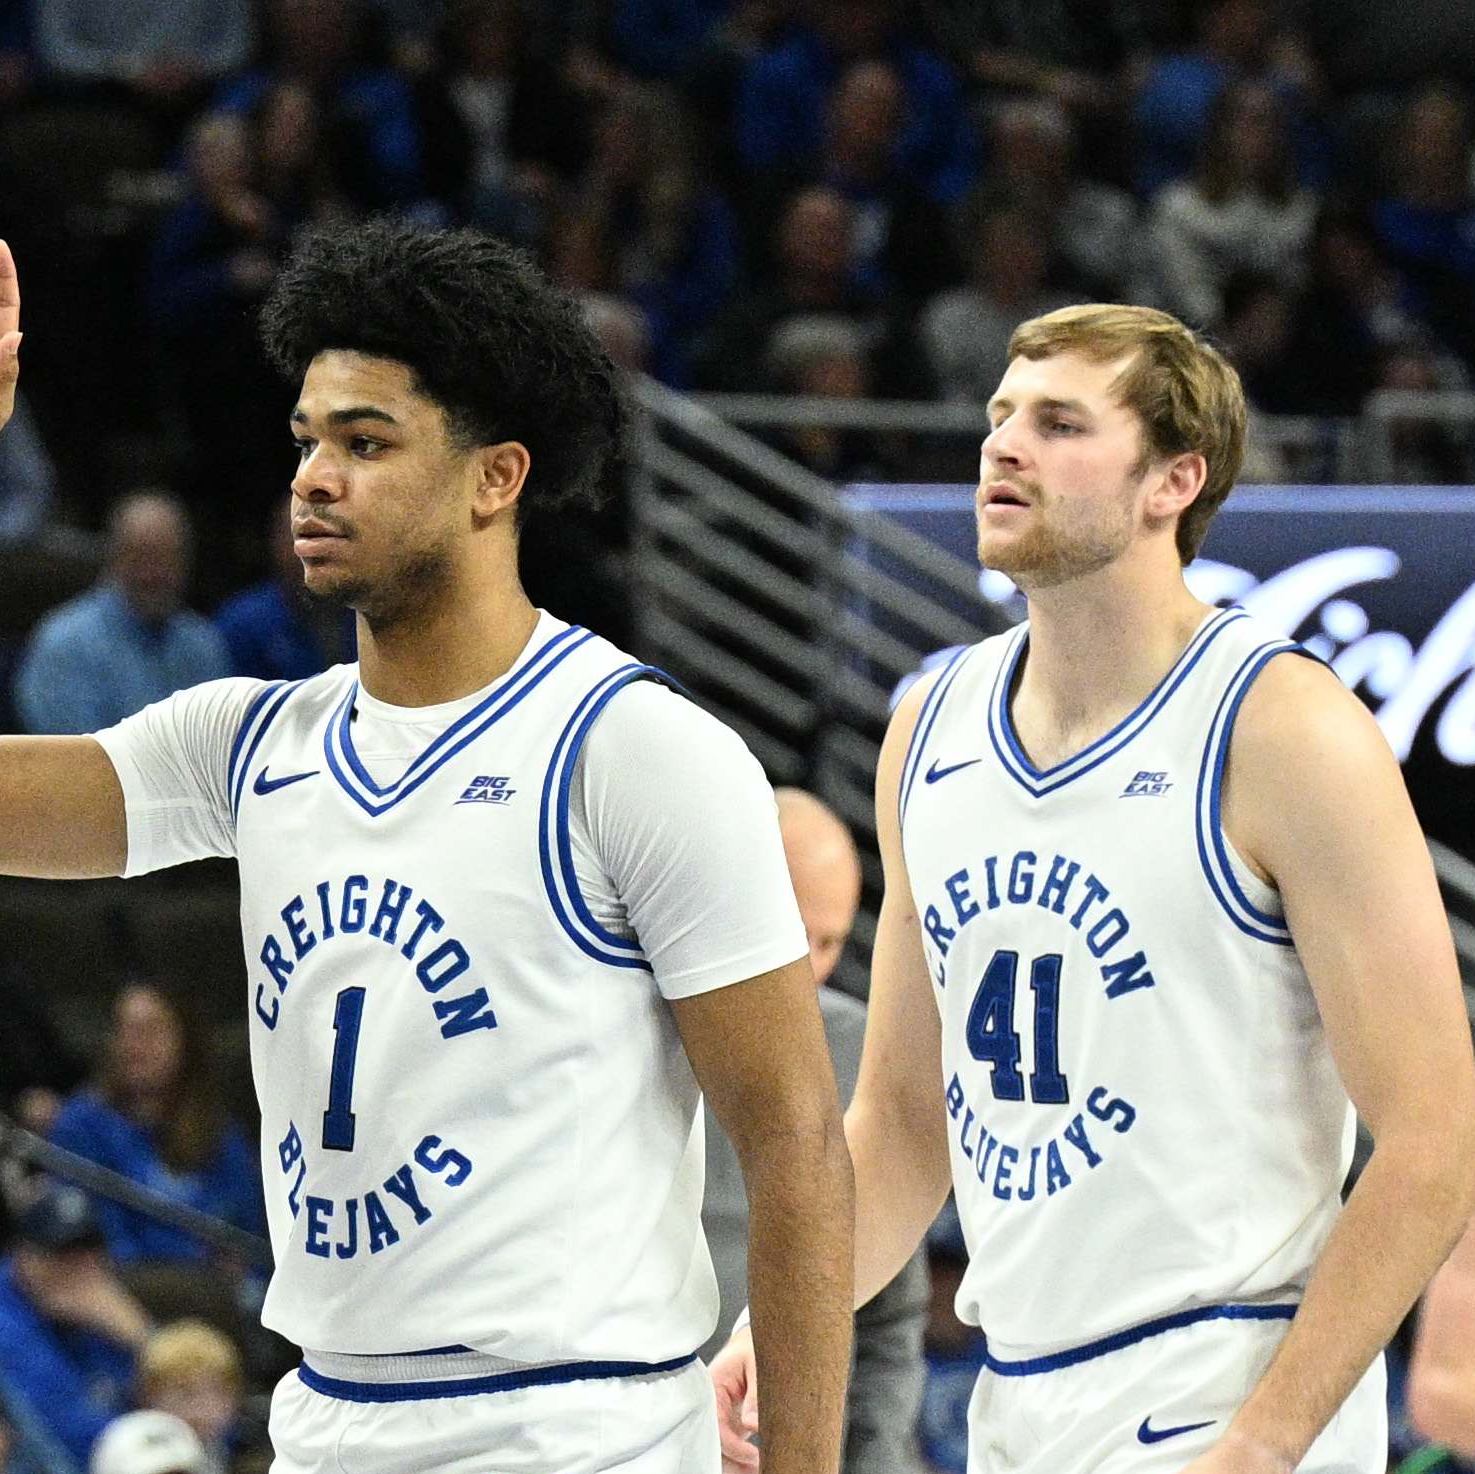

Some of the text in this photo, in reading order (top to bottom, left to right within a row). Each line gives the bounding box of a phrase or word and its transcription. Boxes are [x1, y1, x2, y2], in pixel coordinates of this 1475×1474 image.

[459, 788, 517, 801] EAST
[469, 775, 511, 788] BIG
[1124, 783, 1174, 794] EAST
[1132, 770, 1168, 782] BIG
[255, 874, 498, 1040] CREIGHTON
[322, 986, 367, 1152] 1
[965, 950, 1069, 1104] 41
[278, 1118, 473, 1260] BLEJAYS
[946, 1071, 1137, 1201] BLUEJAYS
